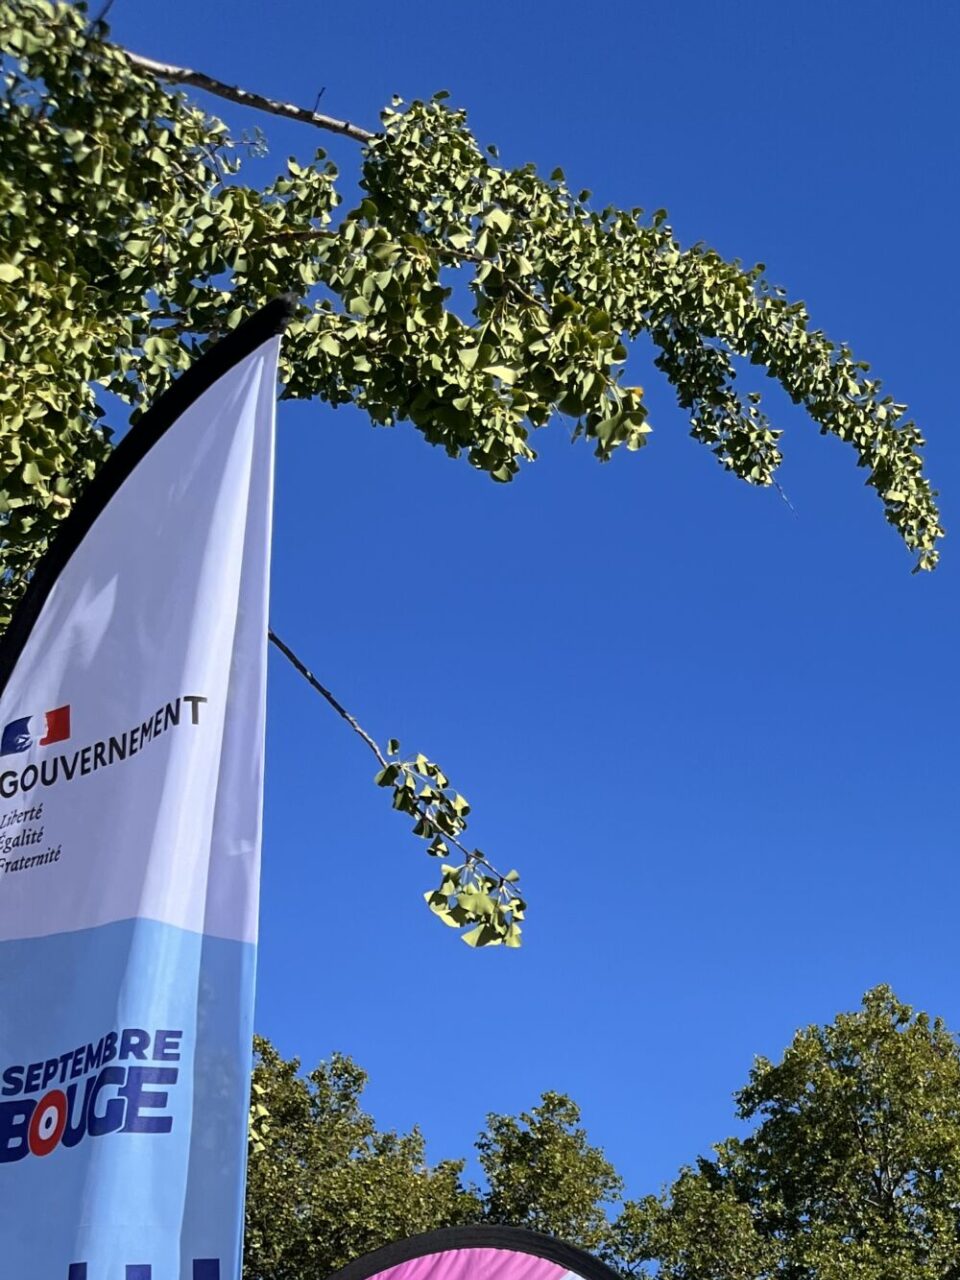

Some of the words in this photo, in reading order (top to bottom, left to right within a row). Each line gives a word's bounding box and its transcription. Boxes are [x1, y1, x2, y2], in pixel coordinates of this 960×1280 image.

[0, 696, 207, 798] GOUVERNEMENT
[0, 803, 43, 829] Liberté
[2, 1029, 183, 1096] SEPTEMBRE
[0, 1066, 179, 1163] BOUGE
